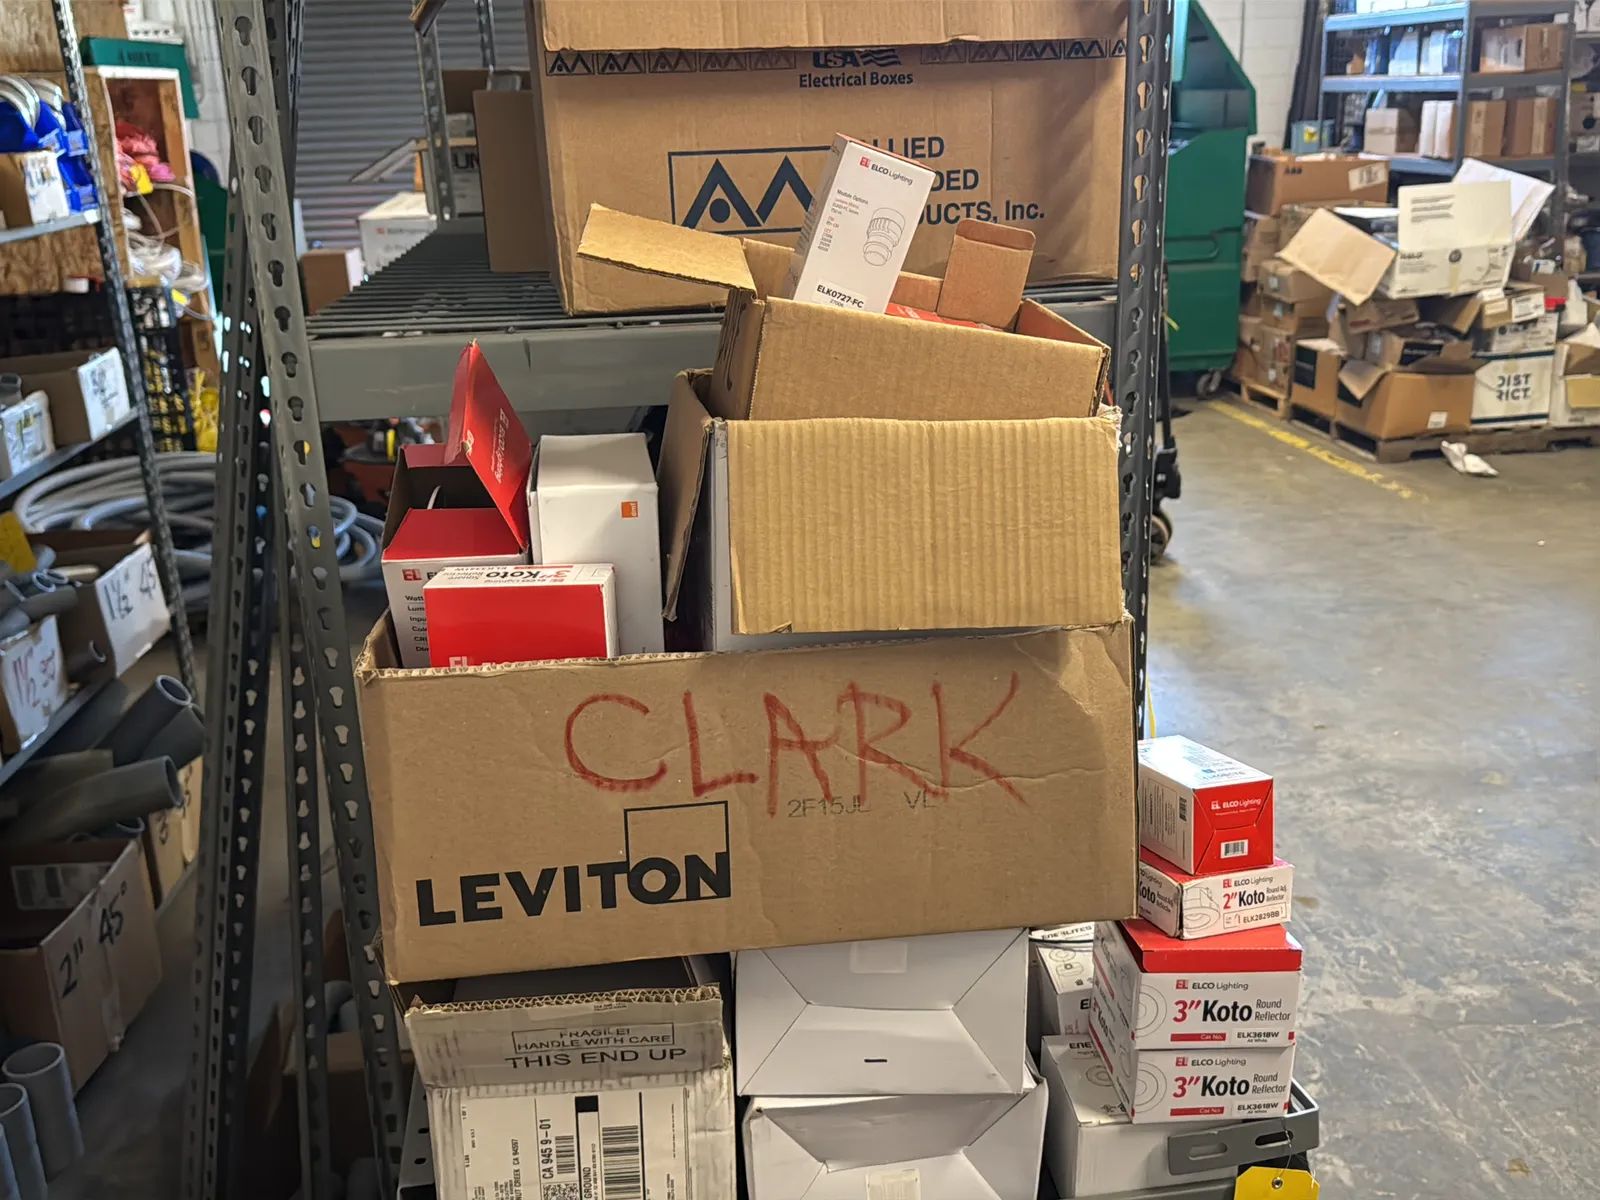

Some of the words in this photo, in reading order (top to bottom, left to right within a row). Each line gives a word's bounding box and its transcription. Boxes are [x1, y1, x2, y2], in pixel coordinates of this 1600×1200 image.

[812, 51, 860, 69] USA
[799, 72, 867, 88] Electrical
[870, 72, 914, 86] Boxes
[860, 136, 945, 159] LIED
[871, 163, 889, 176] ELCO
[888, 171, 914, 186] Lighting
[918, 200, 998, 226] UCTS,
[1005, 200, 1045, 221] Inc.
[816, 284, 864, 308] ELK0727-FC
[401, 568, 422, 581] EL
[486, 570, 541, 579] Koto
[563, 671, 1028, 818] CLARK
[1211, 800, 1221, 810] EL
[1222, 801, 1239, 809] ELCO
[1239, 798, 1262, 807] Lighting
[415, 851, 731, 926] LEVITON
[1222, 878, 1232, 889] EL
[1234, 879, 1250, 887] ELCO
[1250, 876, 1273, 885] Lighting
[1238, 889, 1265, 907] Koto
[1266, 894, 1285, 902] Reflector
[1242, 910, 1280, 924] ELK2829BB
[1175, 979, 1188, 990] EL
[1192, 982, 1215, 990] ELCO
[1216, 982, 1249, 991] Lighting
[1202, 999, 1253, 1022] Koto
[1255, 999, 1282, 1009] Round
[1254, 1010, 1292, 1021] Reflector
[517, 1040, 580, 1051] HANDLE
[584, 1037, 624, 1046] WITH
[628, 1035, 671, 1043] CARE
[504, 1053, 572, 1069] THIS
[581, 1050, 639, 1065] END
[648, 1048, 687, 1061] UP
[1175, 1056, 1188, 1067] EL
[1214, 1058, 1247, 1067] Lighting
[1253, 1072, 1279, 1083] Round
[1200, 1075, 1250, 1097] Koto
[1251, 1084, 1287, 1094] Reflector
[1237, 1102, 1279, 1110] ELK3618W
[512, 1157, 519, 1165] CA
[540, 1147, 553, 1165] 945
[542, 1166, 554, 1180] CA
[582, 1166, 593, 1199] GROUND
